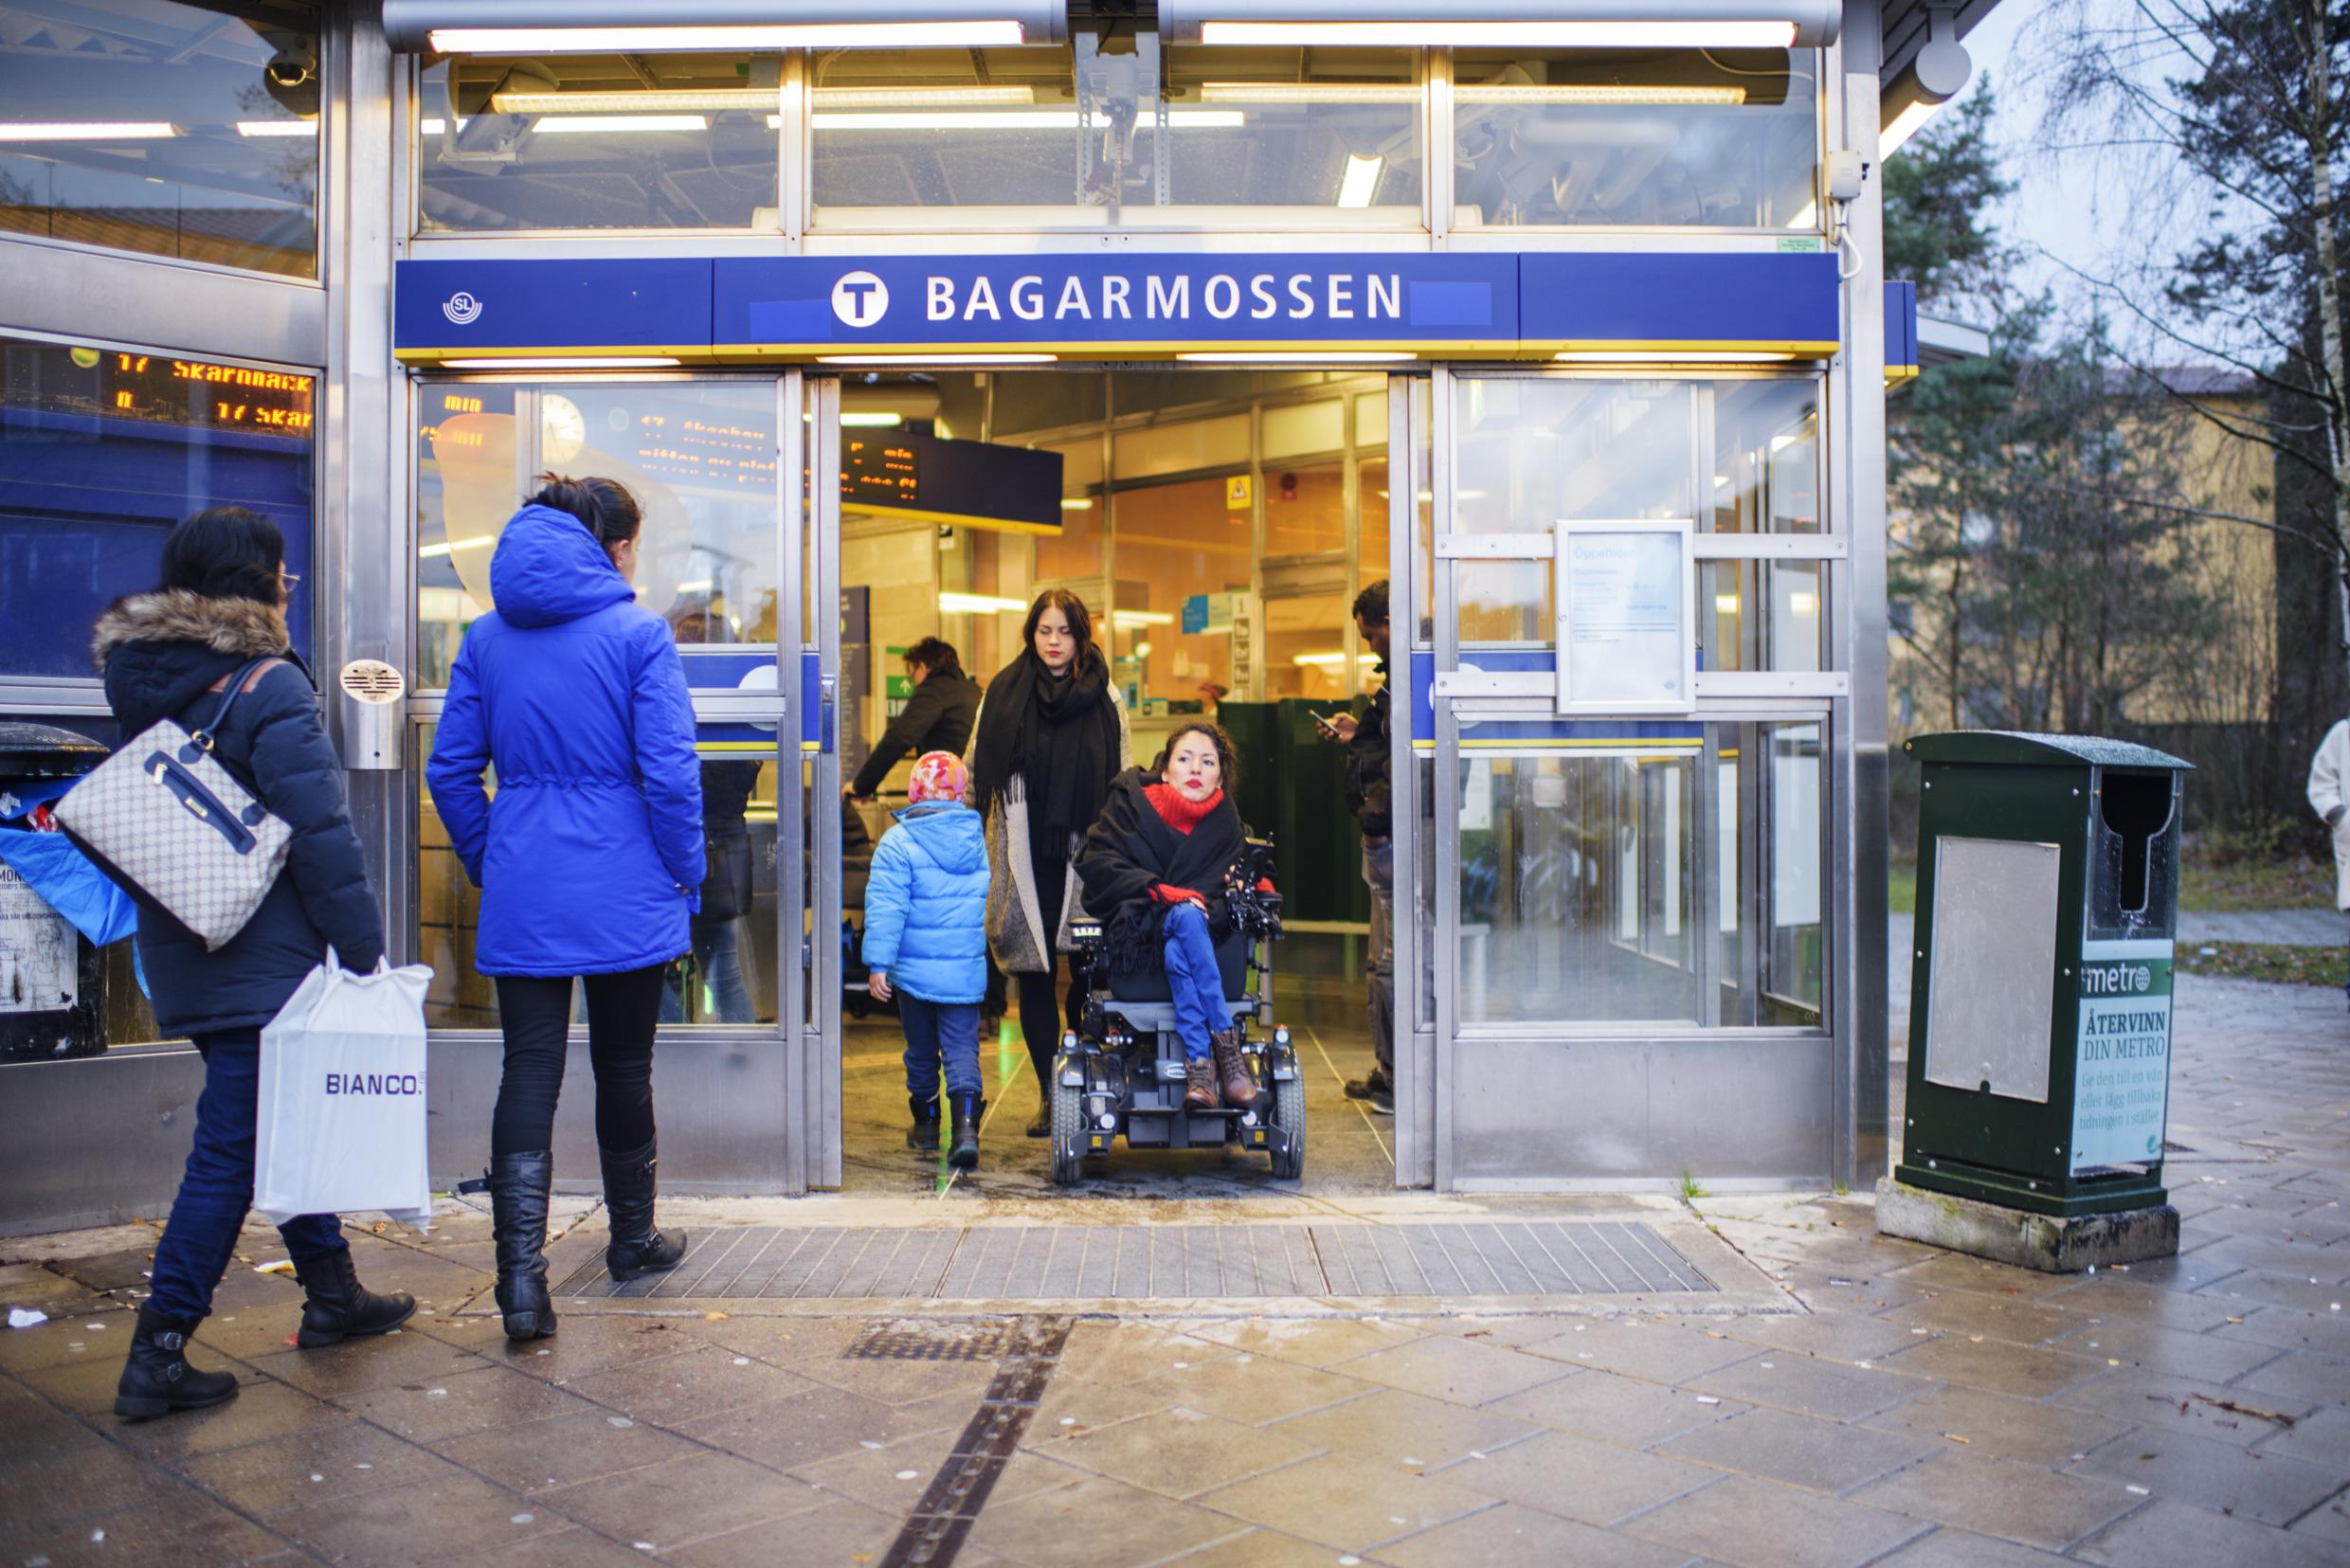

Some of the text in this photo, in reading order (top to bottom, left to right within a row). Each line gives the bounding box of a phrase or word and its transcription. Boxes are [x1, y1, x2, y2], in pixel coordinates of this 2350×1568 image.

[927, 274, 1402, 321] BAGARMOSSEN
[2087, 962, 2150, 993] metro
[2086, 1008, 2166, 1036] ÅTERVINN
[2084, 1036, 2165, 1061] DIN METRO
[2096, 1071, 2114, 1086] den
[2117, 1068, 2130, 1084] till
[2132, 1072, 2144, 1083] en
[2080, 1091, 2102, 1108] eller
[2127, 1088, 2161, 1105] tillbaka
[2079, 1112, 2124, 1131] tidningen
